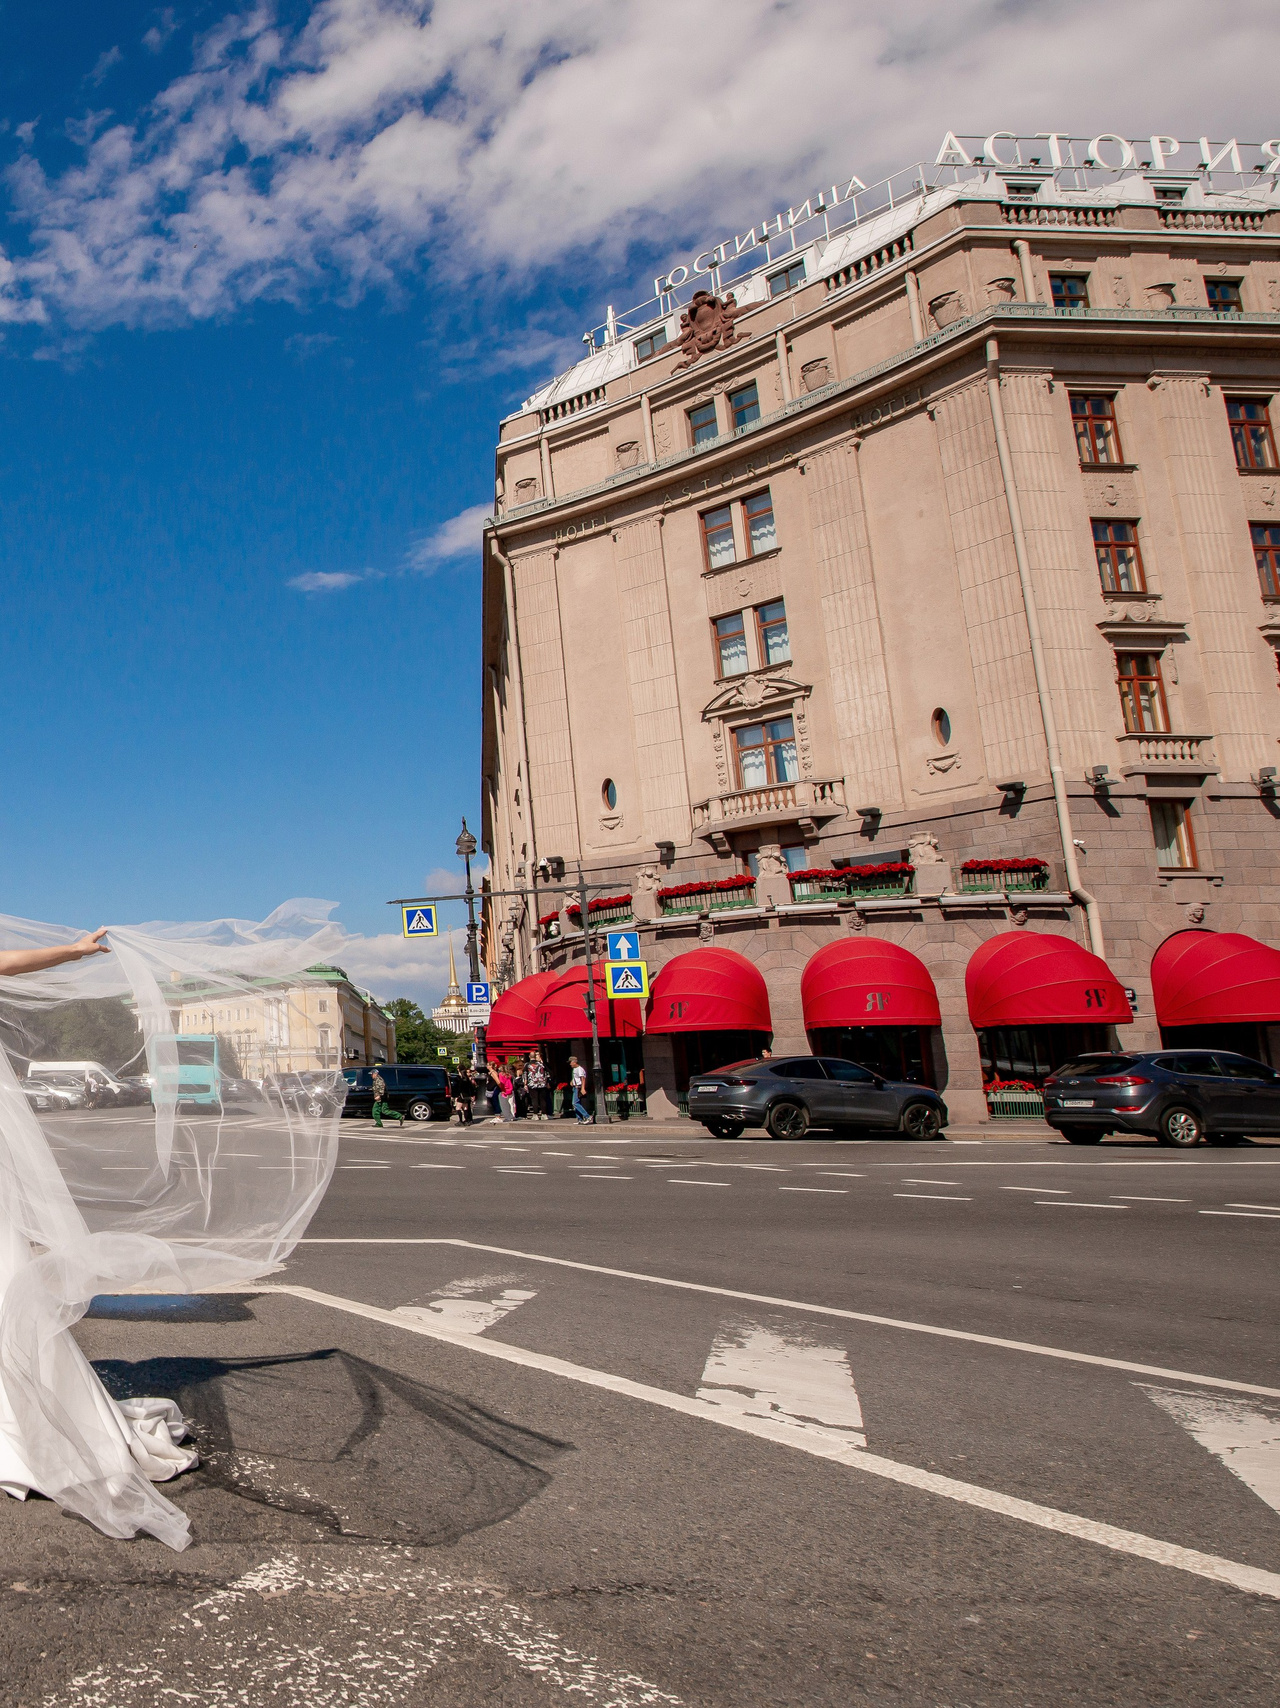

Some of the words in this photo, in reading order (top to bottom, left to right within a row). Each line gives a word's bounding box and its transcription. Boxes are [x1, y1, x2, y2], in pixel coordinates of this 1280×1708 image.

[654, 175, 868, 297] ГОСТИНИЦА
[555, 515, 609, 544] HOTEL
[661, 447, 794, 511] ASTORIA
[854, 387, 925, 433] HOTEL
